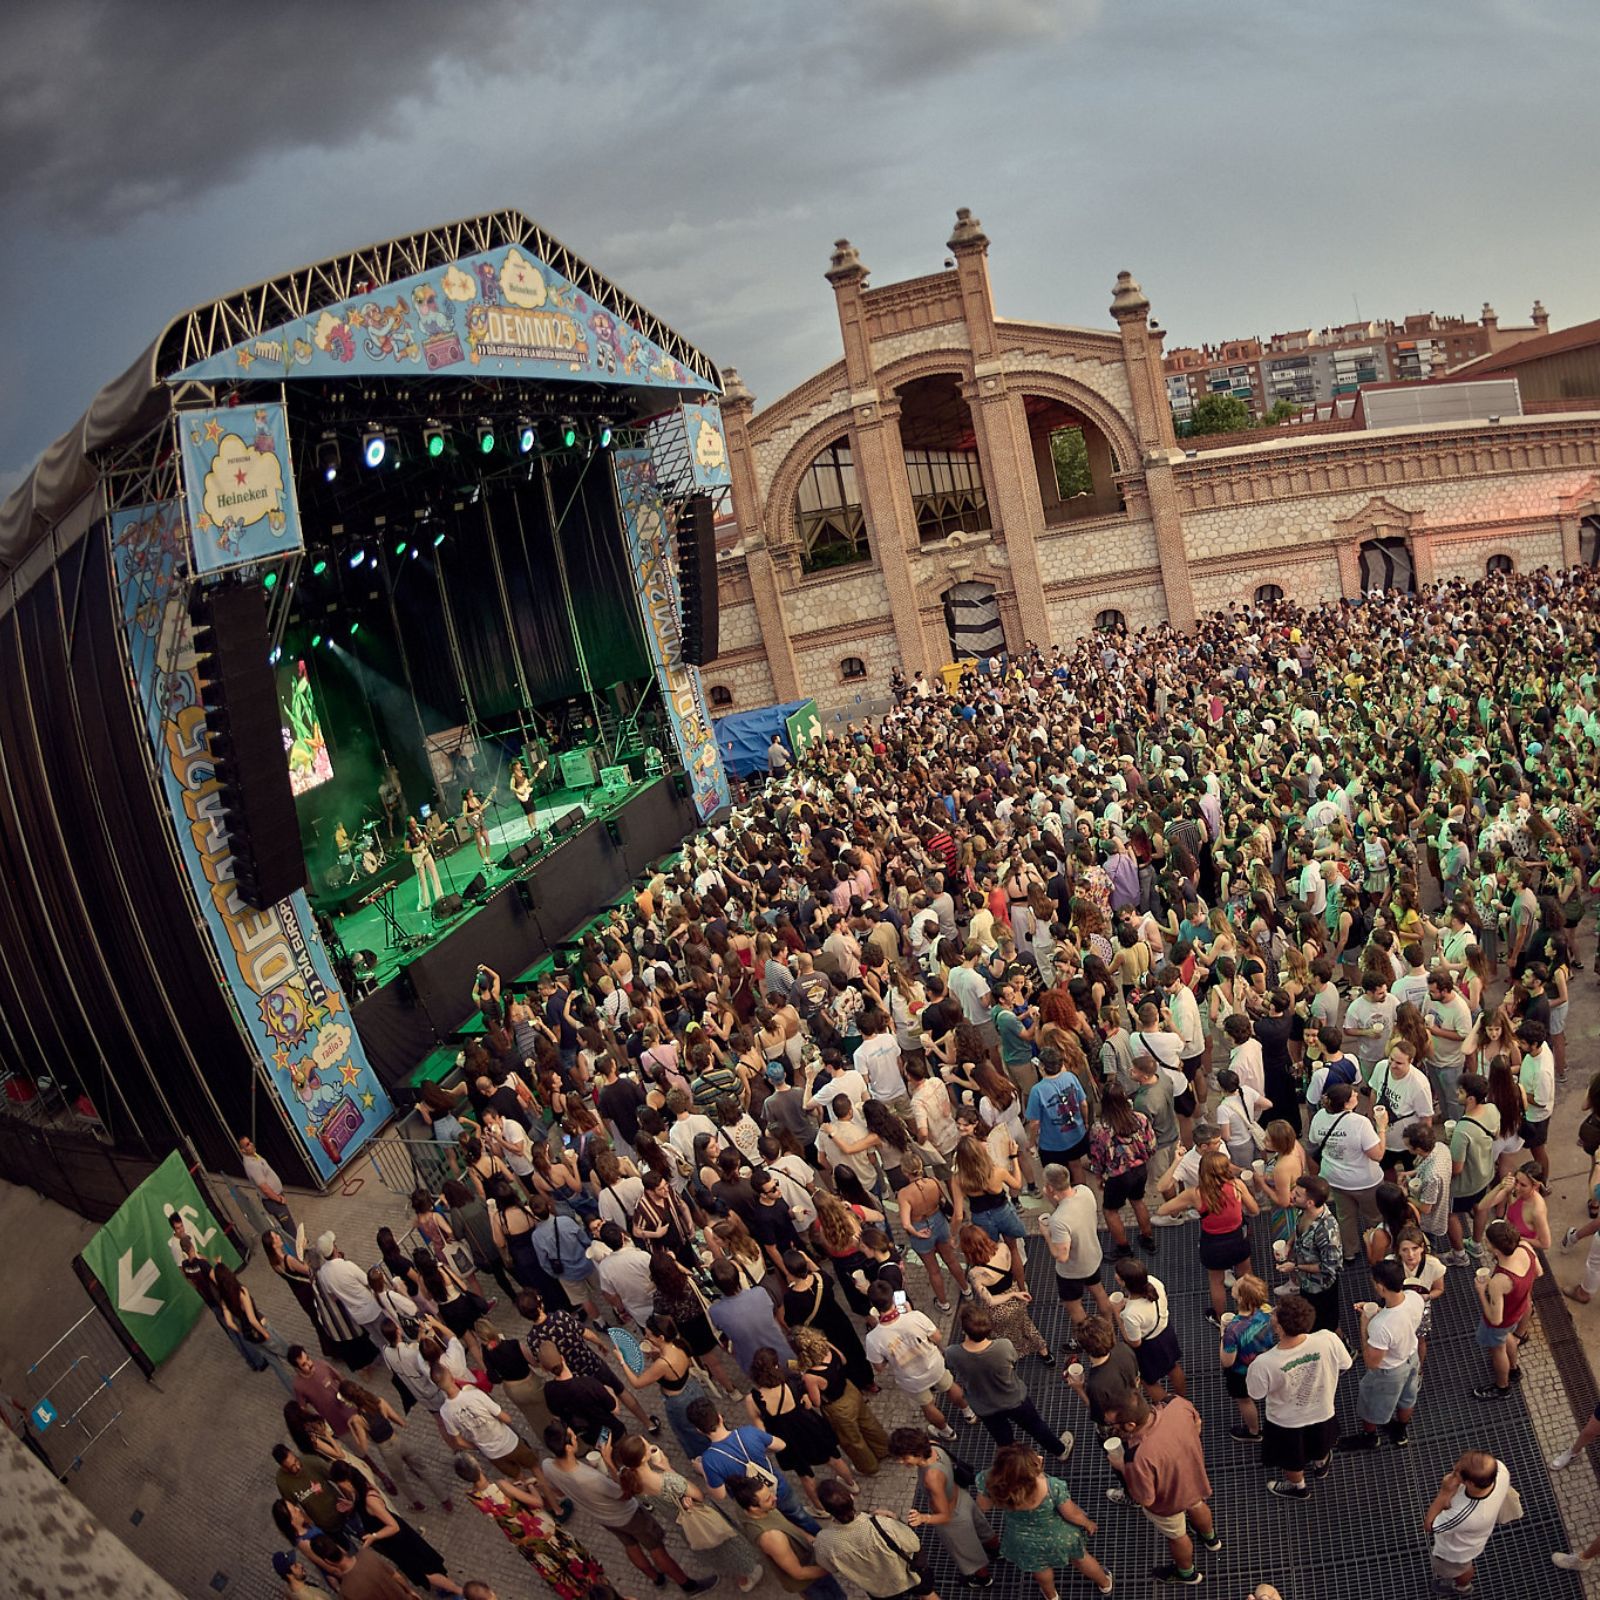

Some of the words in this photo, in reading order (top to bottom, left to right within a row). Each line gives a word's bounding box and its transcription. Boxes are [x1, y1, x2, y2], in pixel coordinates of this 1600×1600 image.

[488, 312, 576, 351] DEMM25
[217, 488, 268, 508] Heineken
[298, 949, 314, 979] DÍA
[321, 1041, 339, 1060] radio
